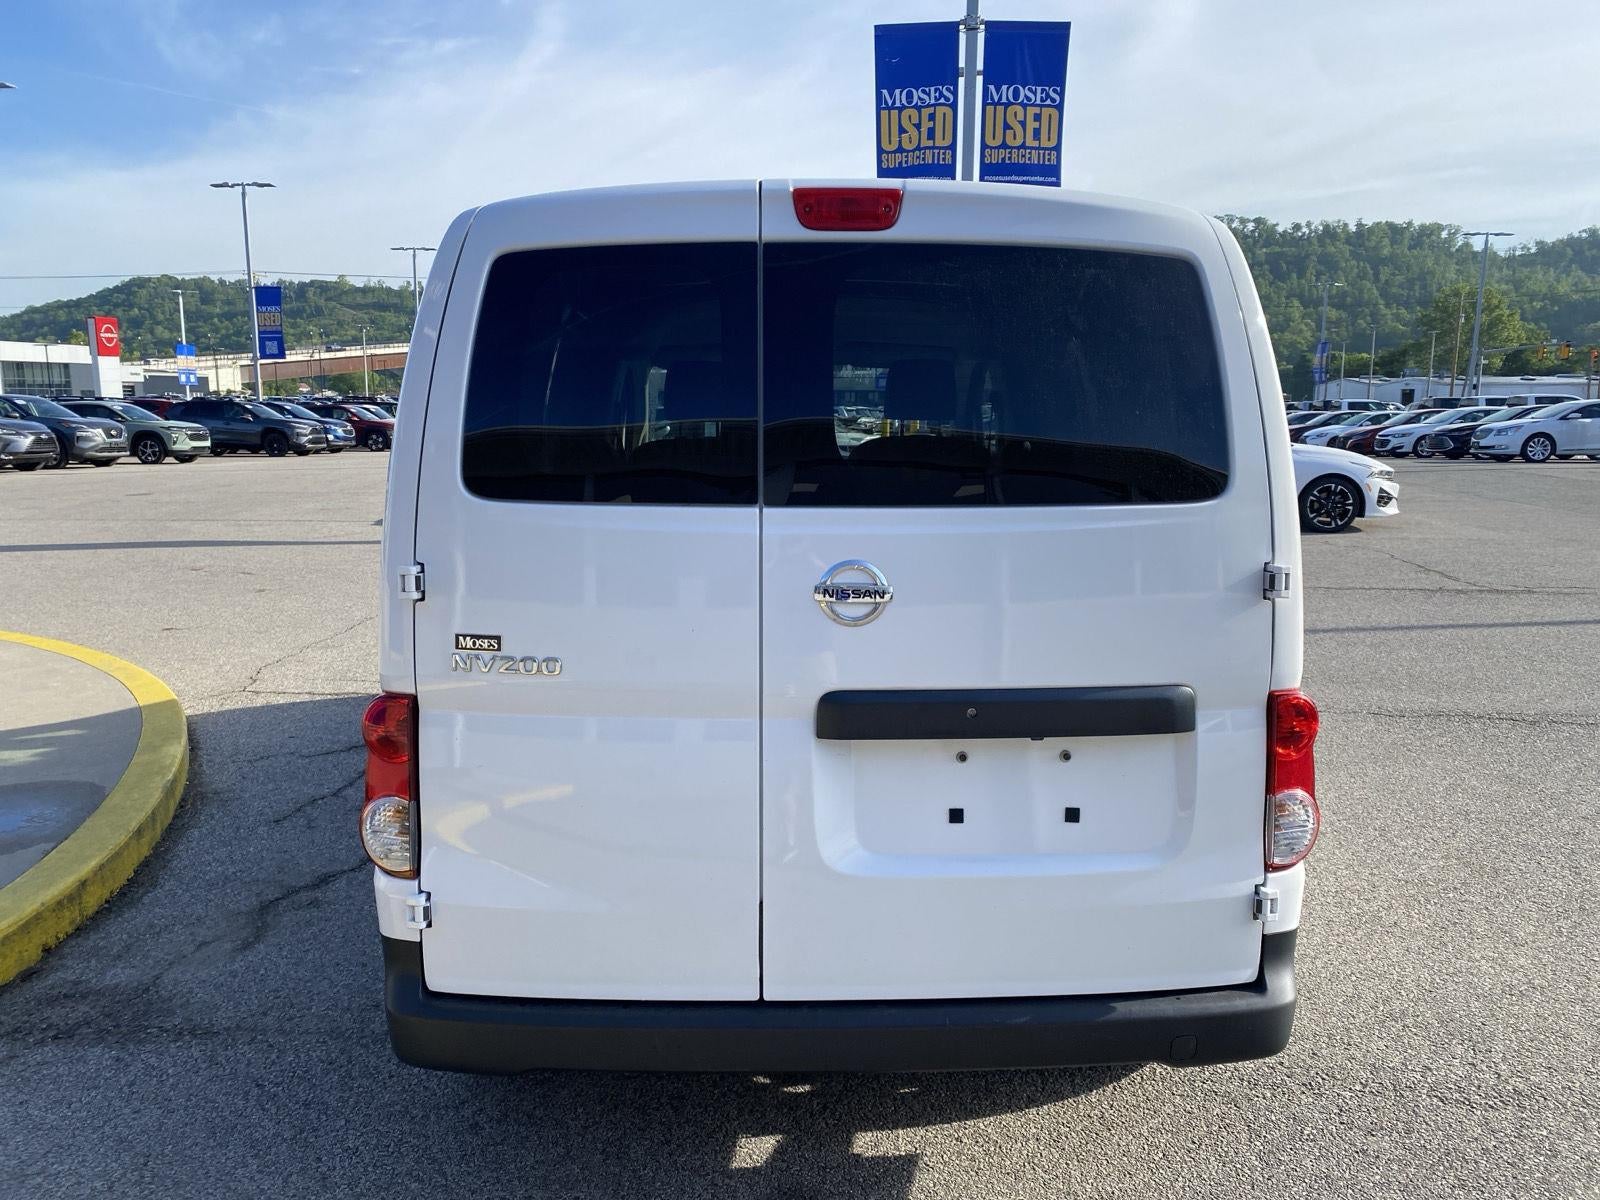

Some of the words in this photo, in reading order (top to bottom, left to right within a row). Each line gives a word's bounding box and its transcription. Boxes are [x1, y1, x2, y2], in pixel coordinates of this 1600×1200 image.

[880, 85, 954, 107] MOSES
[986, 84, 1061, 106] MOSES
[880, 105, 954, 152] USED
[984, 105, 1060, 148] USED
[881, 149, 953, 169] SUPERCENTER
[984, 149, 1057, 165] SUPERCENTER
[984, 174, 1057, 182] mosesusedsupercenter.com
[258, 312, 281, 326] USED
[822, 588, 886, 601] NISSAN
[451, 652, 563, 676] NV200
